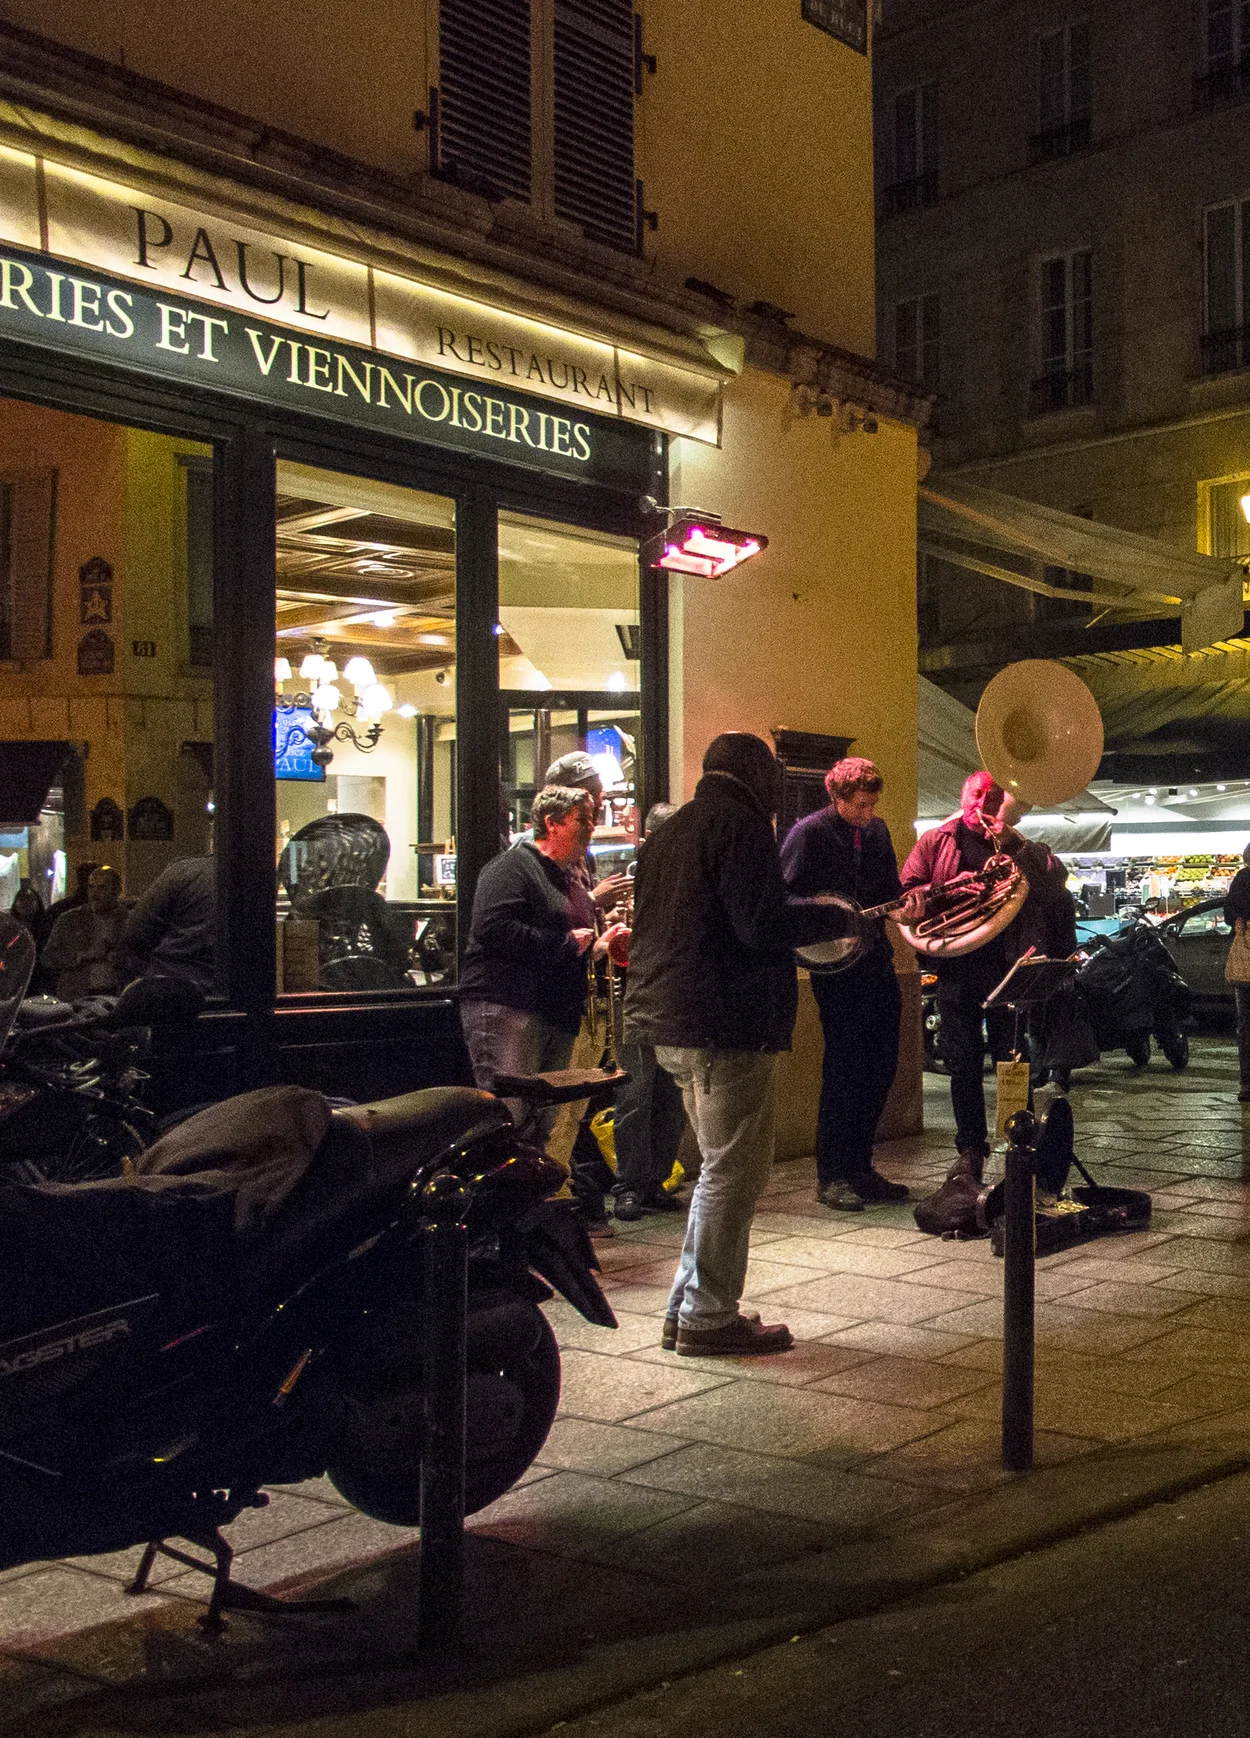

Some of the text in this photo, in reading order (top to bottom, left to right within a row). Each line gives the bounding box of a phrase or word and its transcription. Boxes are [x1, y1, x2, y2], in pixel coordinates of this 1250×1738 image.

[130, 206, 330, 320] PAUL
[156, 303, 228, 362] ET
[245, 327, 590, 461] VIENNOISERIES
[435, 326, 654, 413] RESTAURANT
